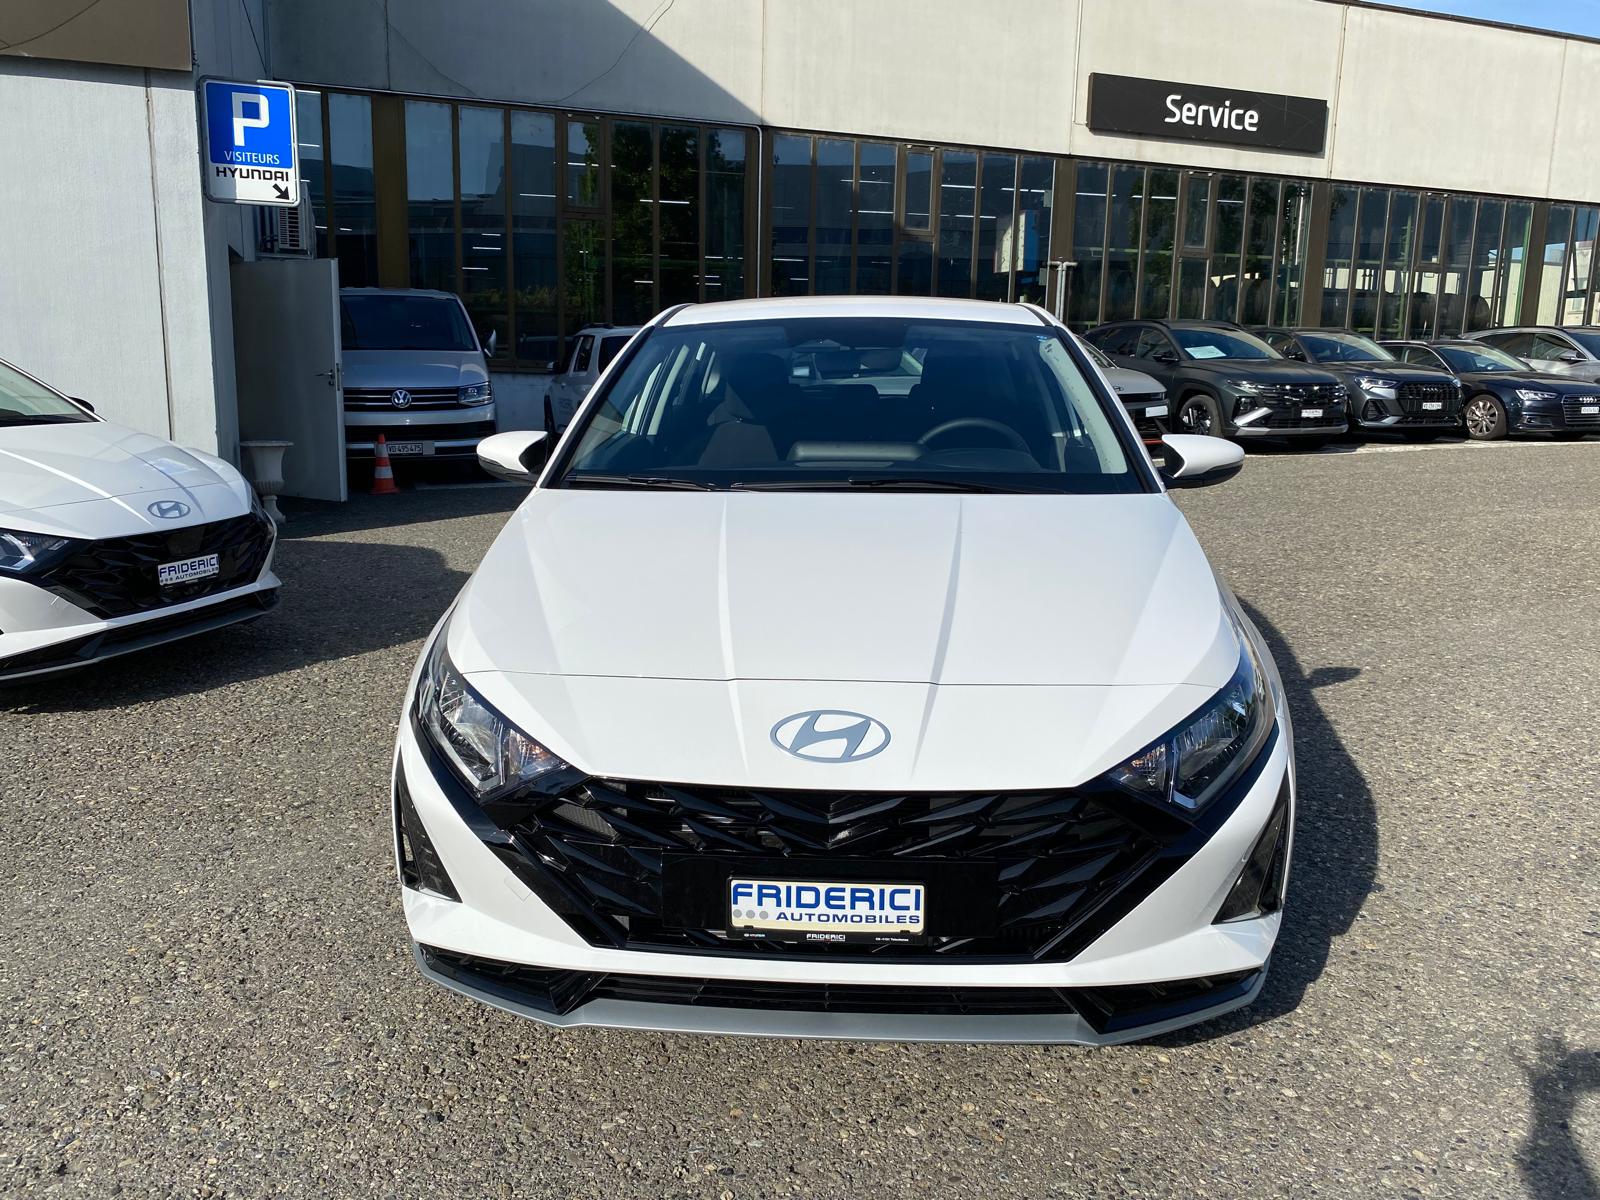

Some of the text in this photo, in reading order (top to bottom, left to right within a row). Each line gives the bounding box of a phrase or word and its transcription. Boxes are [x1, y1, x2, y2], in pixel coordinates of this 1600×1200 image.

[231, 91, 270, 147] P
[1164, 94, 1260, 132] Service
[224, 150, 280, 165] VISITEURS
[215, 166, 289, 182] HYUNDAI
[175, 566, 219, 581] AUTOMOBILES
[733, 883, 921, 911] FRIDERICI
[775, 911, 921, 924] AUTOMOBILES
[806, 933, 846, 941] FRIDERICI
